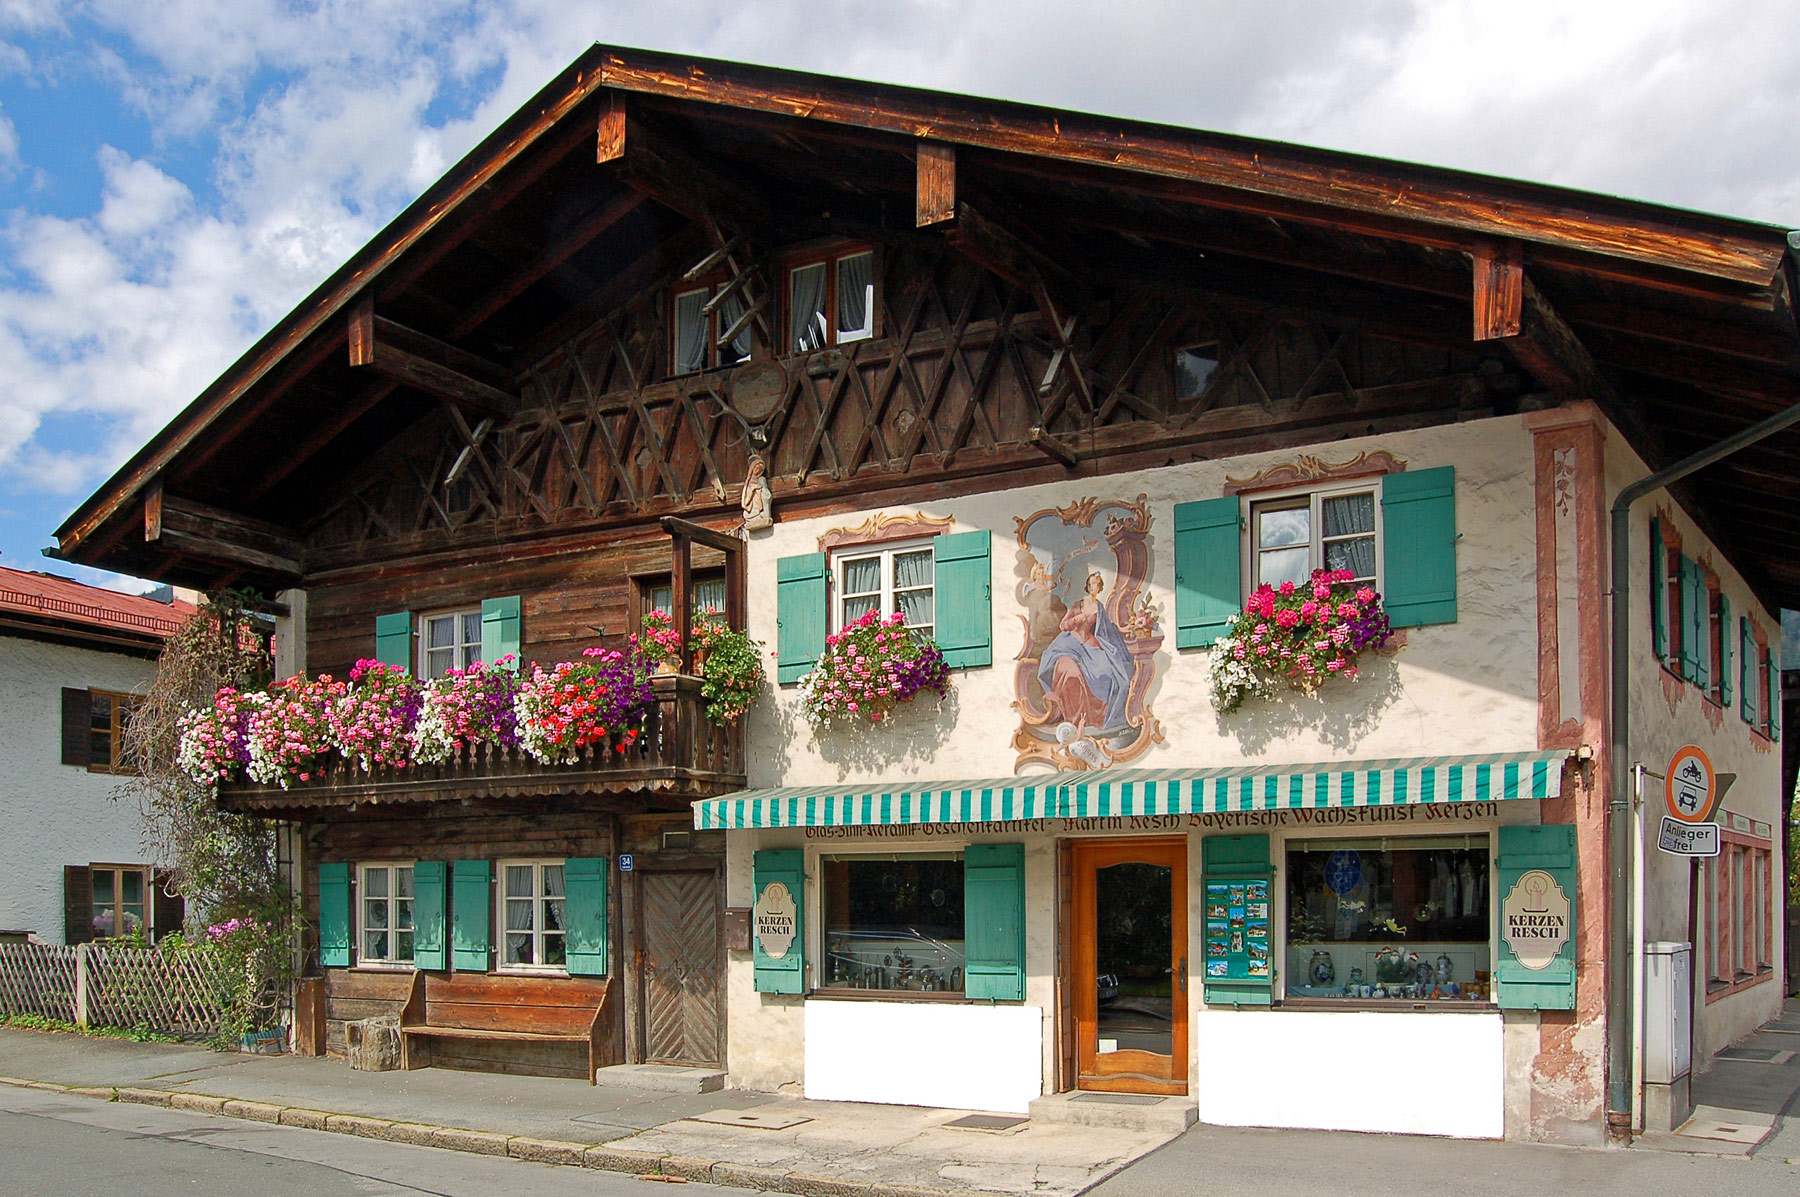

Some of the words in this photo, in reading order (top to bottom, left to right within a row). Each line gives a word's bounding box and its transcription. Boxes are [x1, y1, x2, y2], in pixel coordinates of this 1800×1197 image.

[1189, 810, 1288, 830] Bayerische
[1291, 802, 1416, 825] Wachskunst
[1425, 802, 1499, 820] Kerzen
[1666, 823, 1710, 840] Anlieger
[1673, 838, 1693, 851] frei
[622, 857, 631, 866] 34
[758, 916, 793, 925] KERZEN
[1508, 915, 1564, 927] KERZEN
[760, 925, 790, 935] RESCH
[1511, 927, 1559, 939] RESCH
